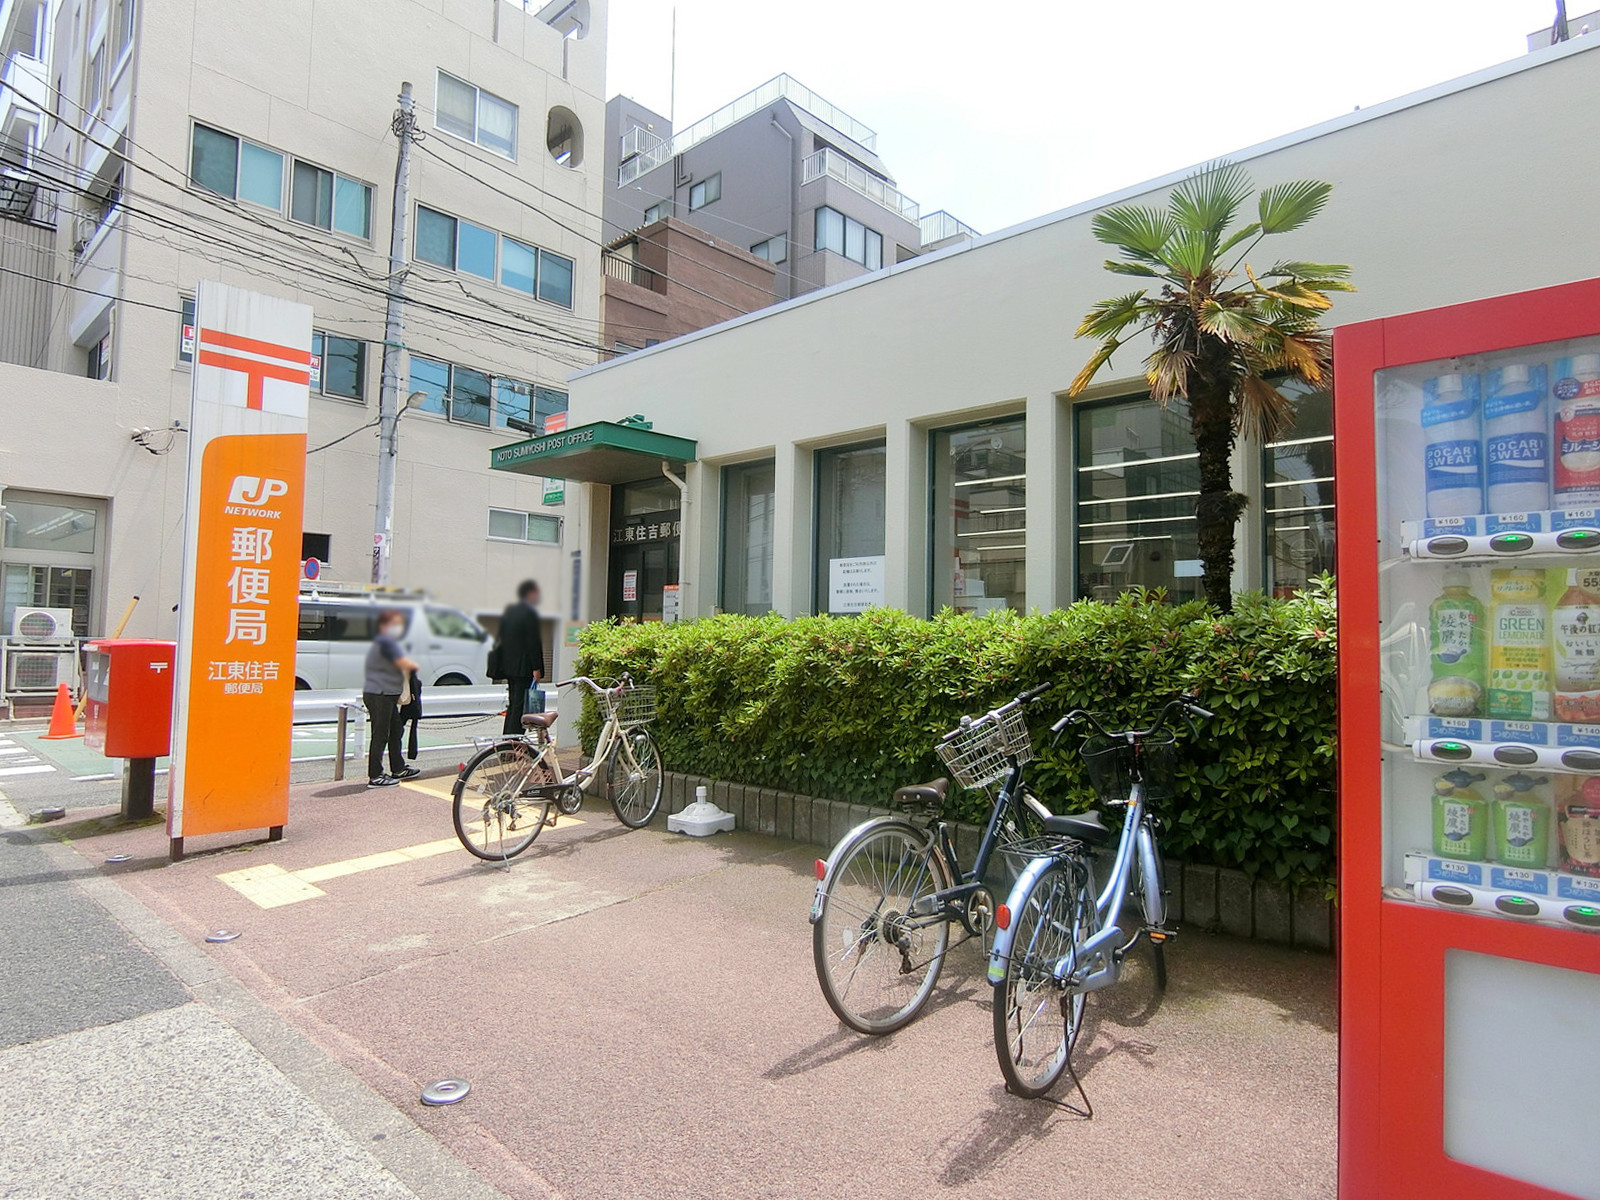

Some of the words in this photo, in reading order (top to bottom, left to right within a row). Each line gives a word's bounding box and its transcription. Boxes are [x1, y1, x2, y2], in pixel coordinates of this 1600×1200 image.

[497, 449, 513, 462] KOTO
[513, 441, 545, 459] SUMIYOSHI
[547, 436, 565, 450] POST
[567, 429, 594, 446] OFFICE
[1489, 439, 1544, 453] POCARI
[1427, 446, 1477, 460] POCARI
[1489, 448, 1539, 462] SWEAT
[1427, 454, 1472, 468] SWEAT
[228, 475, 289, 506] JP
[224, 505, 282, 519] NETWORK
[1567, 510, 1593, 518] ¥160
[1438, 517, 1459, 525] ¥160
[224, 526, 274, 645] 郵便局
[1583, 577, 1600, 587] 55
[1500, 617, 1545, 631] GREEN
[1499, 630, 1545, 641] LEMONADE
[208, 660, 280, 681] 江東住吉
[224, 682, 264, 695] 郵便局
[1507, 722, 1530, 730] ¥160
[1444, 863, 1466, 872] ¥130
[1508, 871, 1530, 879] ¥130
[1576, 879, 1599, 890] ¥130
